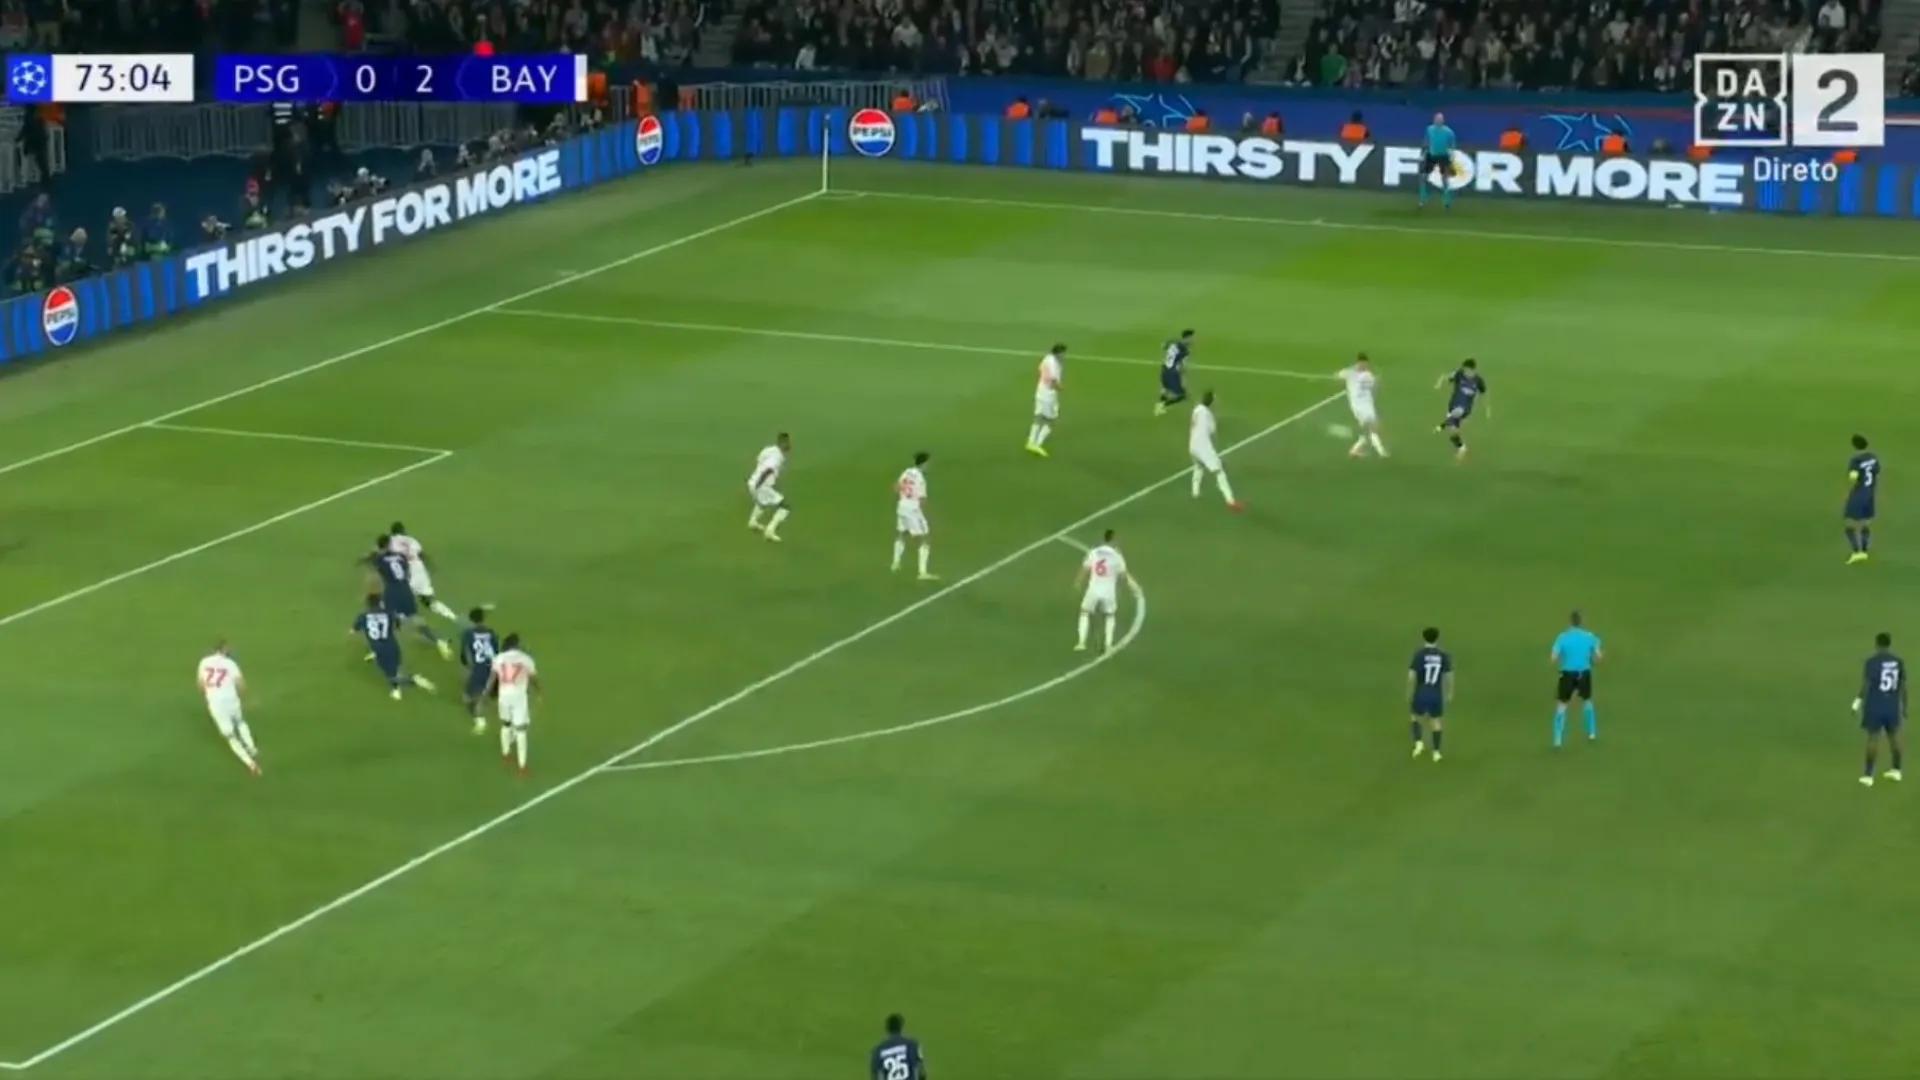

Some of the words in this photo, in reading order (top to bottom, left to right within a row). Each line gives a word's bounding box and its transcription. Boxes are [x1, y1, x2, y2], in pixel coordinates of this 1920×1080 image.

[1081, 126, 1375, 180] THIRSTY
[1536, 154, 1745, 205] MORE
[186, 206, 367, 298] THIRSTY
[372, 184, 451, 245] FOR
[456, 149, 562, 220] MORE
[1095, 558, 1107, 577] 6
[501, 662, 524, 684] 17
[1424, 664, 1441, 685] 17
[1880, 668, 1899, 692] 51
[883, 1054, 909, 1080] 25
